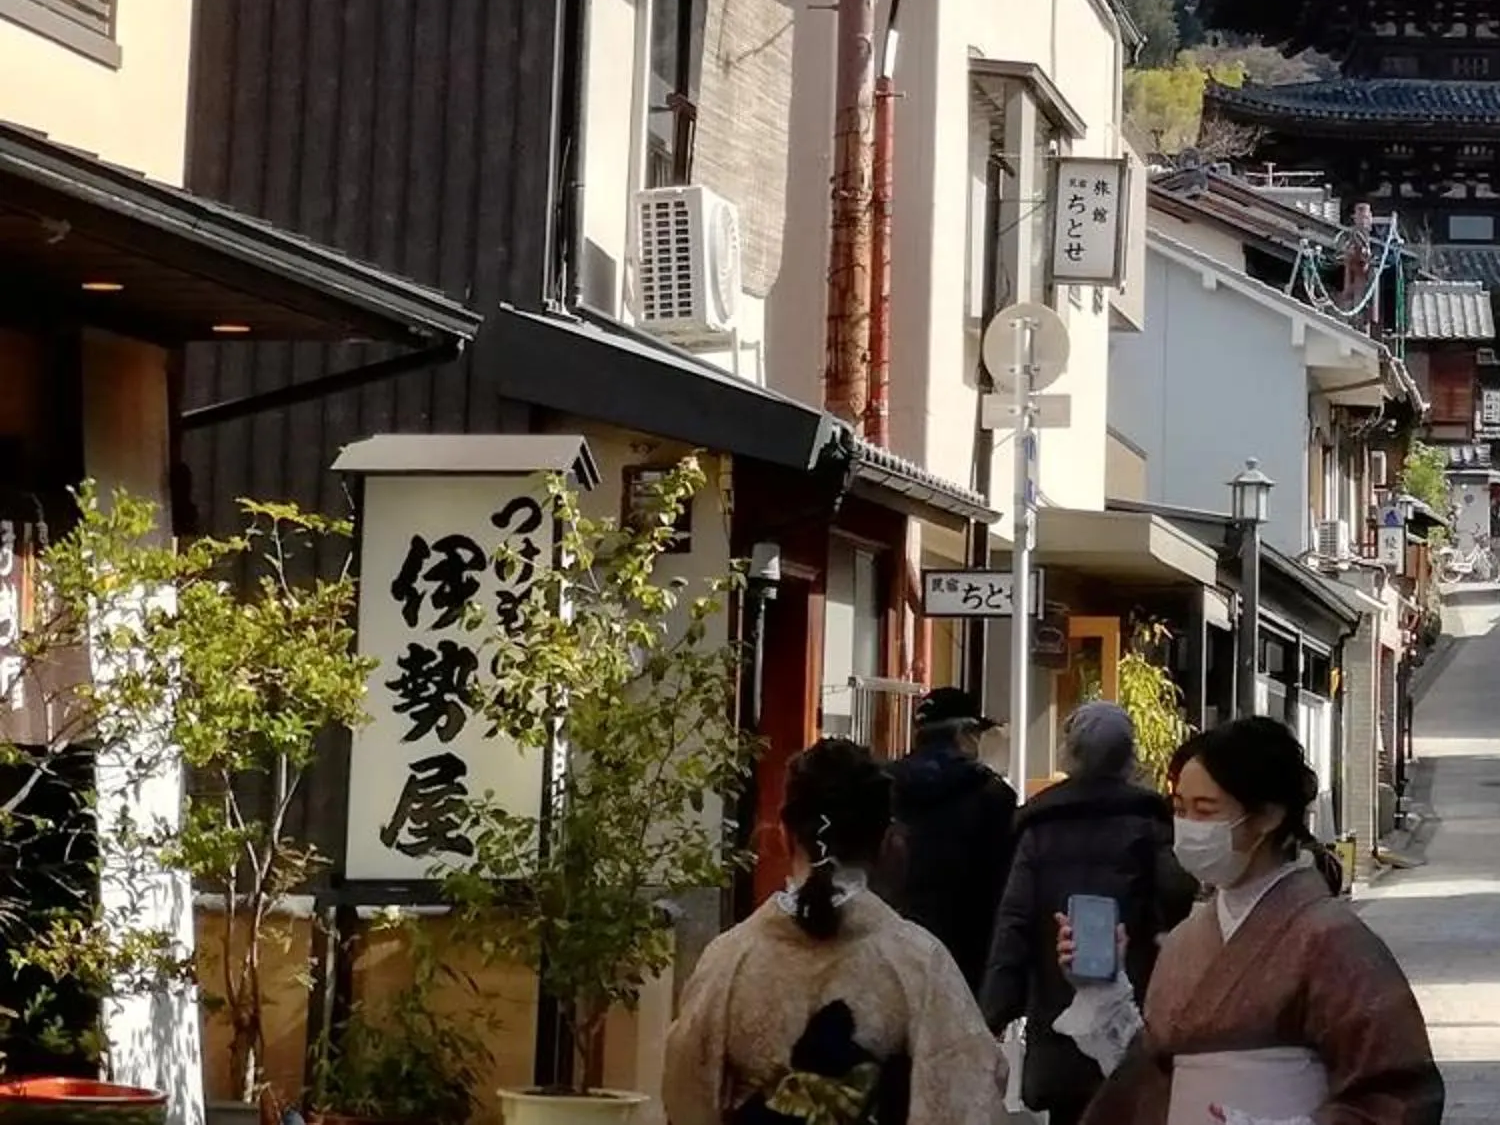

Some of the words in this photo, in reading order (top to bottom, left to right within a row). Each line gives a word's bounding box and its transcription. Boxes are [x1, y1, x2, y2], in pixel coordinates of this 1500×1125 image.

[1063, 194, 1087, 262] ちとせ
[380, 534, 487, 858] 伊勢屋
